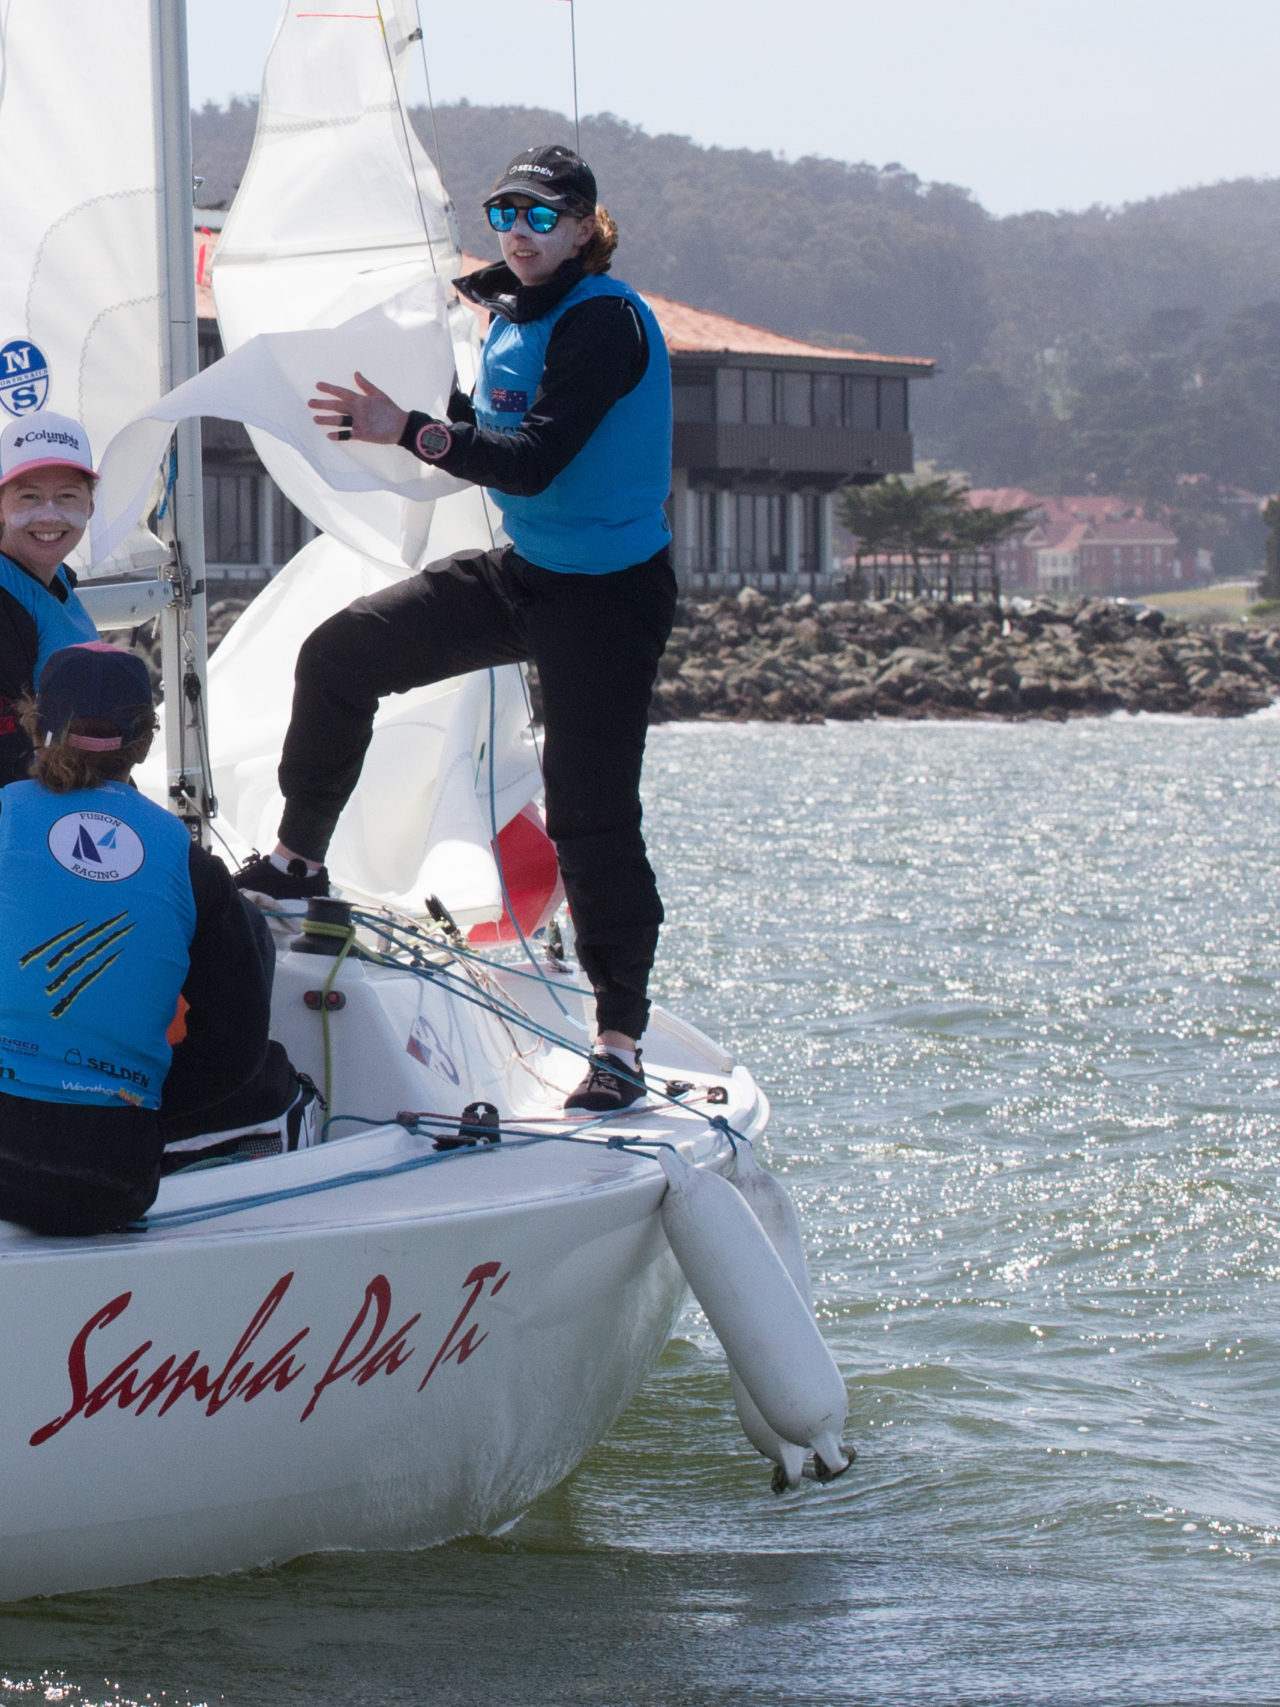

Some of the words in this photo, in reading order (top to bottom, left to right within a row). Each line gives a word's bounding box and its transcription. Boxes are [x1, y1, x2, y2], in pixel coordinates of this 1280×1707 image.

[3, 347, 31, 374] N
[11, 384, 38, 410] S
[25, 429, 79, 446] Columbia
[80, 812, 122, 828] FUSION
[70, 863, 120, 880] RACING
[419, 1015, 460, 1086] 3
[29, 1271, 311, 1447] Samba
[300, 1274, 422, 1423] Pa
